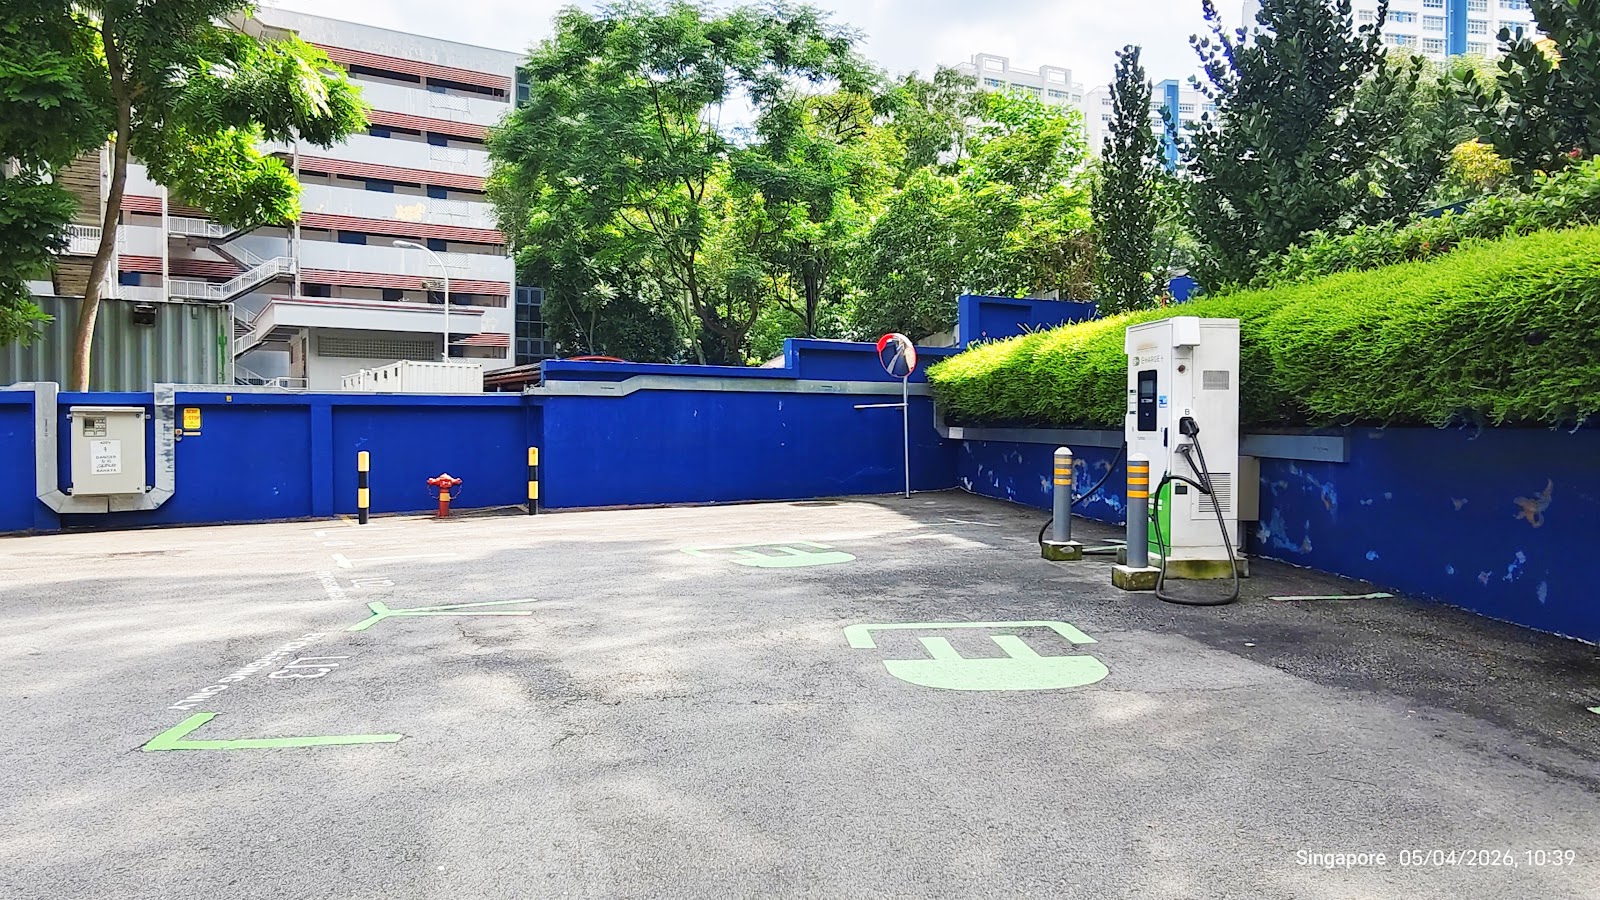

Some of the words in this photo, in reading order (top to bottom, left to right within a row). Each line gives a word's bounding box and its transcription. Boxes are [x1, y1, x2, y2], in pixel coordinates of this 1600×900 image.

[1184, 408, 1191, 416] B
[267, 656, 351, 679] L13
[168, 684, 229, 711] ONLY
